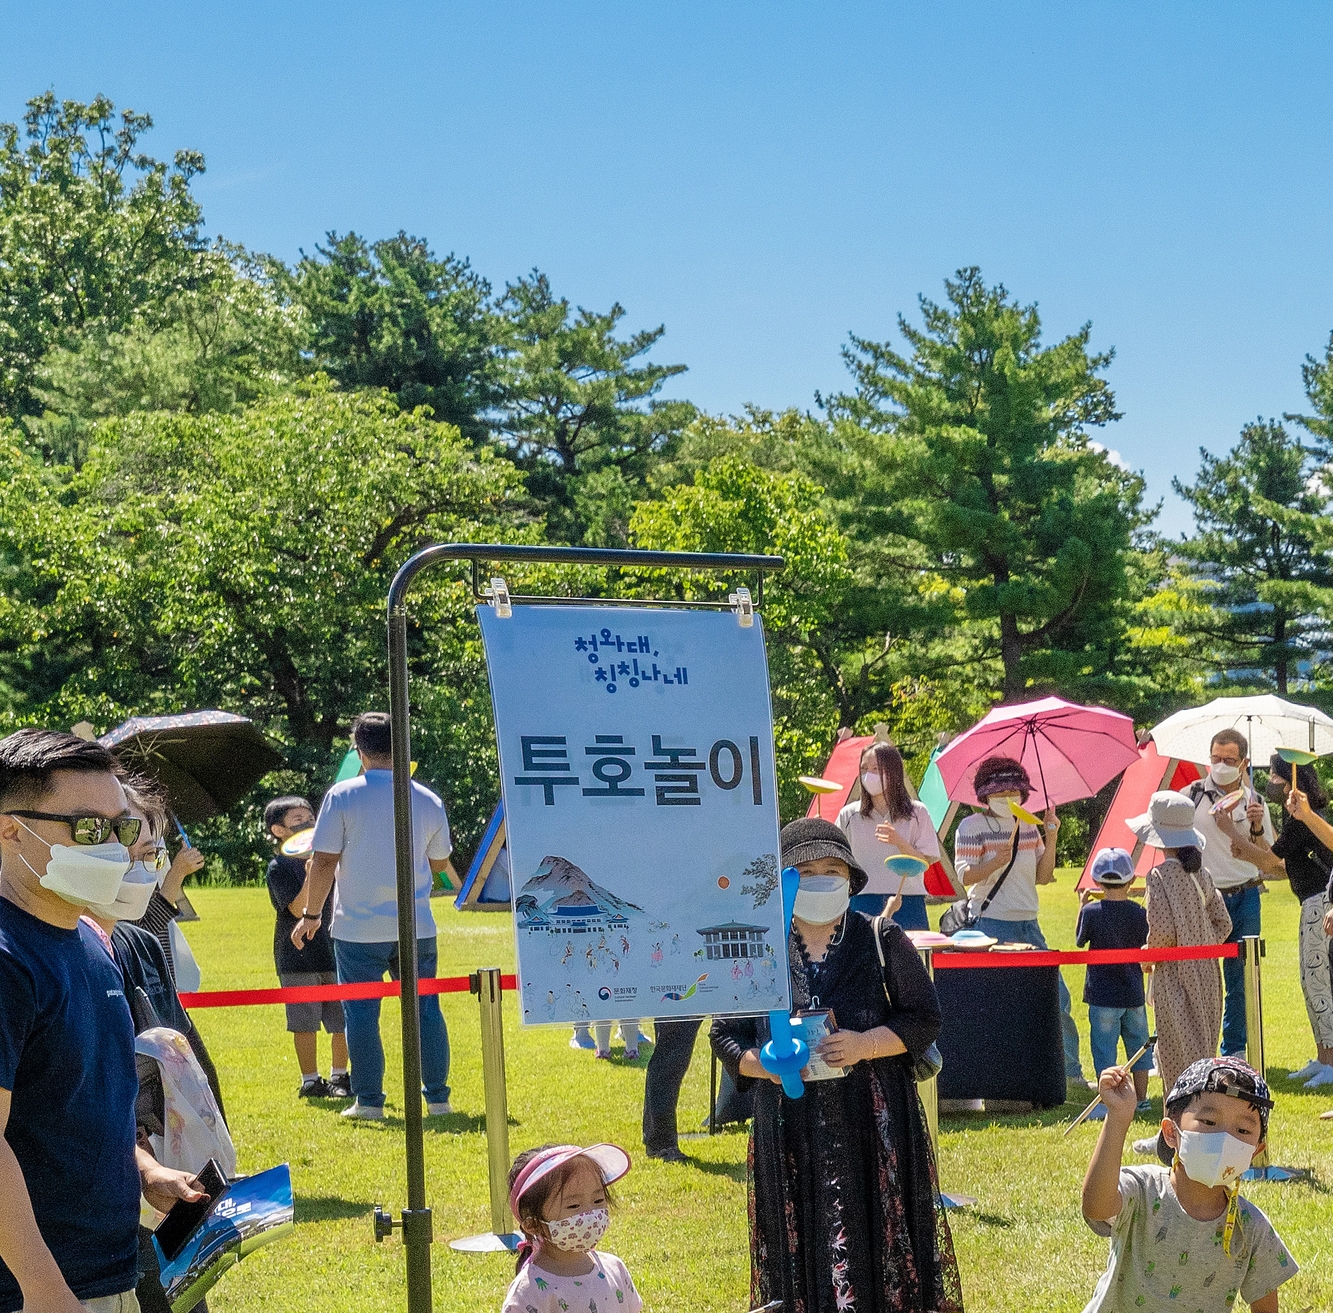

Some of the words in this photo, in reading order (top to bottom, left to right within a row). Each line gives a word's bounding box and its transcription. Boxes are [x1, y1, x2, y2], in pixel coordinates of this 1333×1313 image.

[574, 628, 659, 664] 청와대,
[594, 658, 689, 694] 칭칭나네
[514, 734, 763, 806] 투호놀이
[613, 987, 638, 995] 문화재청
